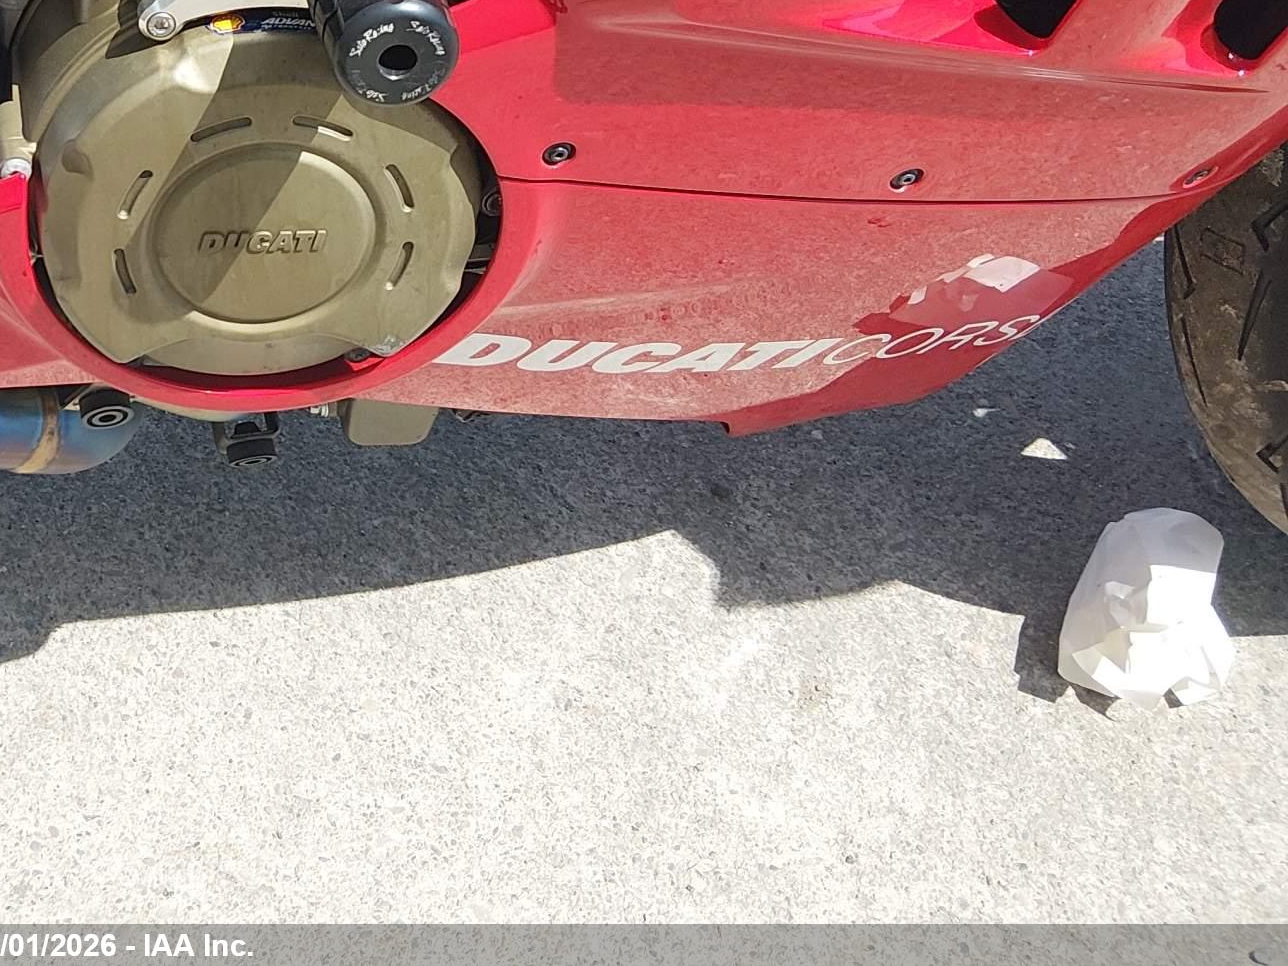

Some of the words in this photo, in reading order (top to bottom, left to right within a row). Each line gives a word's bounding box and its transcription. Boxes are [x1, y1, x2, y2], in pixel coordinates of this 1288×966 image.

[260, 17, 316, 27] ADVAN
[198, 230, 327, 254] DUCATI
[822, 313, 1042, 366] CORS
